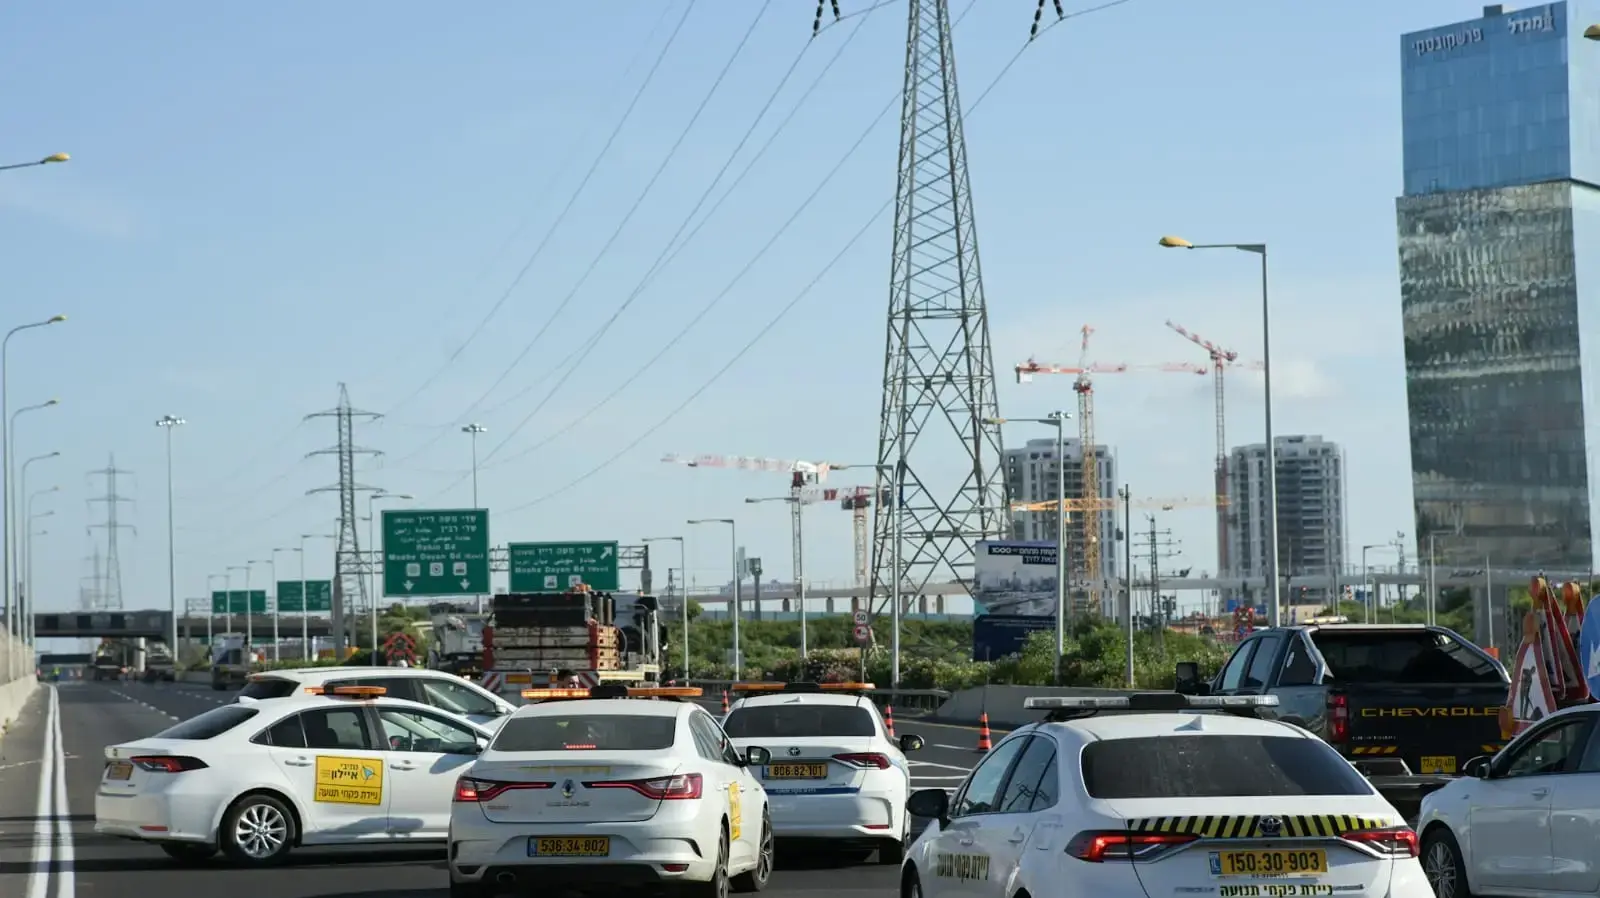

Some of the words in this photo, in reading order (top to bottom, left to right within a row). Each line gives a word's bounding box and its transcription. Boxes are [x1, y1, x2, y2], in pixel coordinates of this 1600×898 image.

[1507, 14, 1543, 35] מגדל
[1361, 706, 1500, 718] CHEVROLE
[331, 769, 359, 780] איילון
[341, 789, 359, 800] פקחי
[955, 854, 971, 884] פקחי
[972, 855, 991, 881] ניידת
[1219, 884, 1260, 897] תנועה
[1263, 884, 1297, 898] פקחי
[1300, 884, 1333, 897] ניידת
